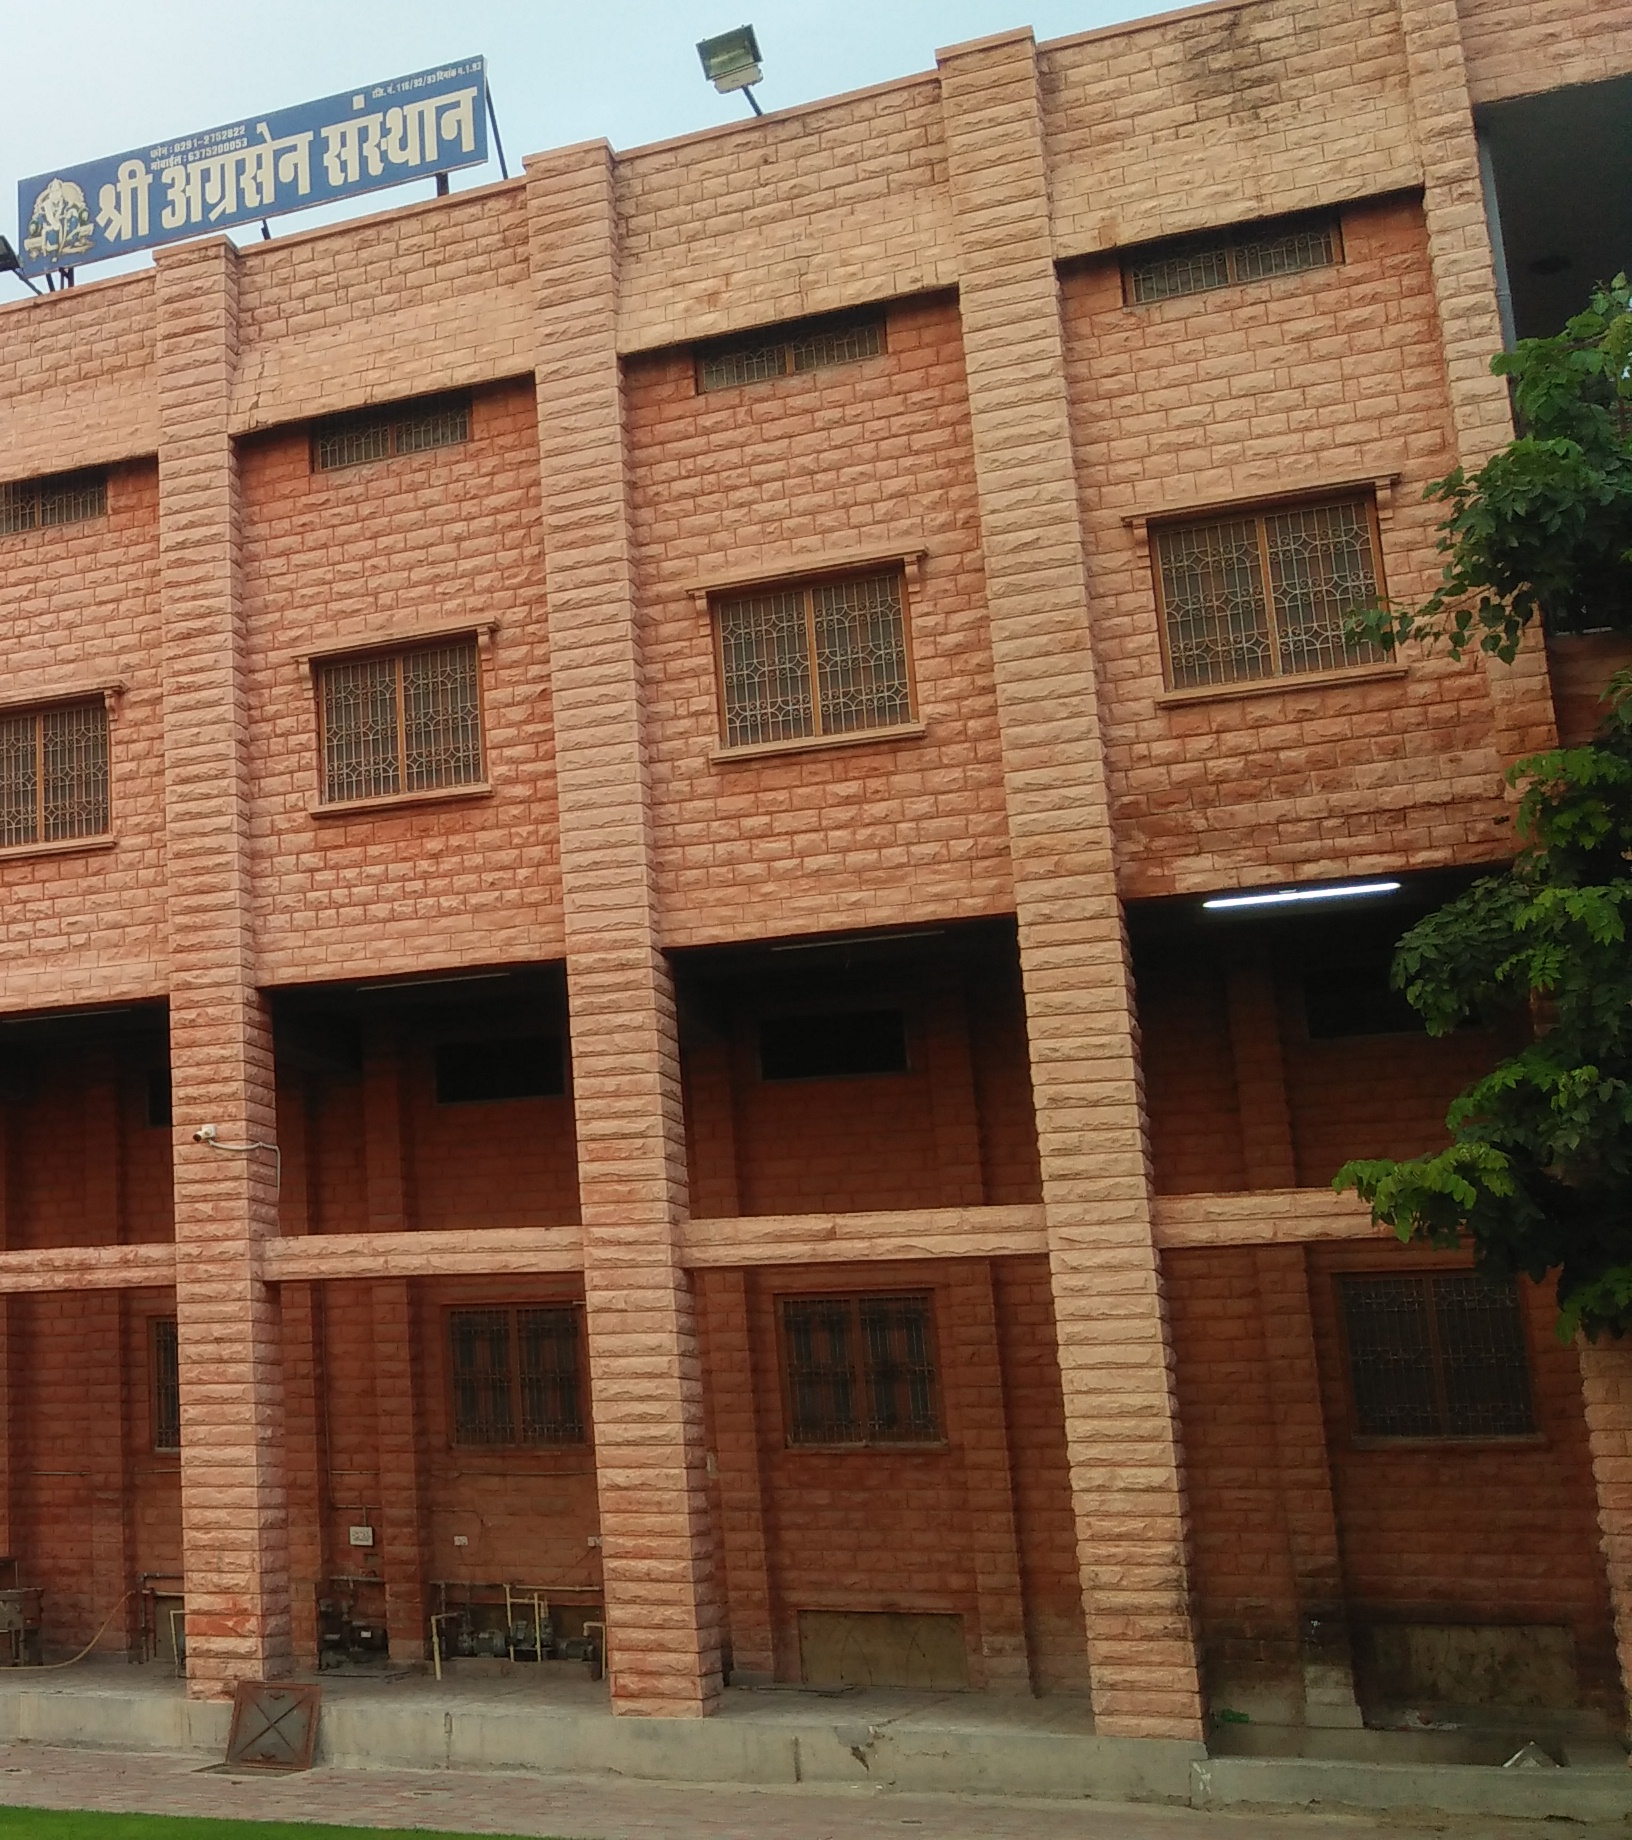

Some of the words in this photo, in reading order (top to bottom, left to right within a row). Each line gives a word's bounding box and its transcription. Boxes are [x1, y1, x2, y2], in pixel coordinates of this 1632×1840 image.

[95, 160, 154, 242] श्री
[161, 122, 314, 228] अग्रसेन
[321, 86, 478, 187] संस्थान
